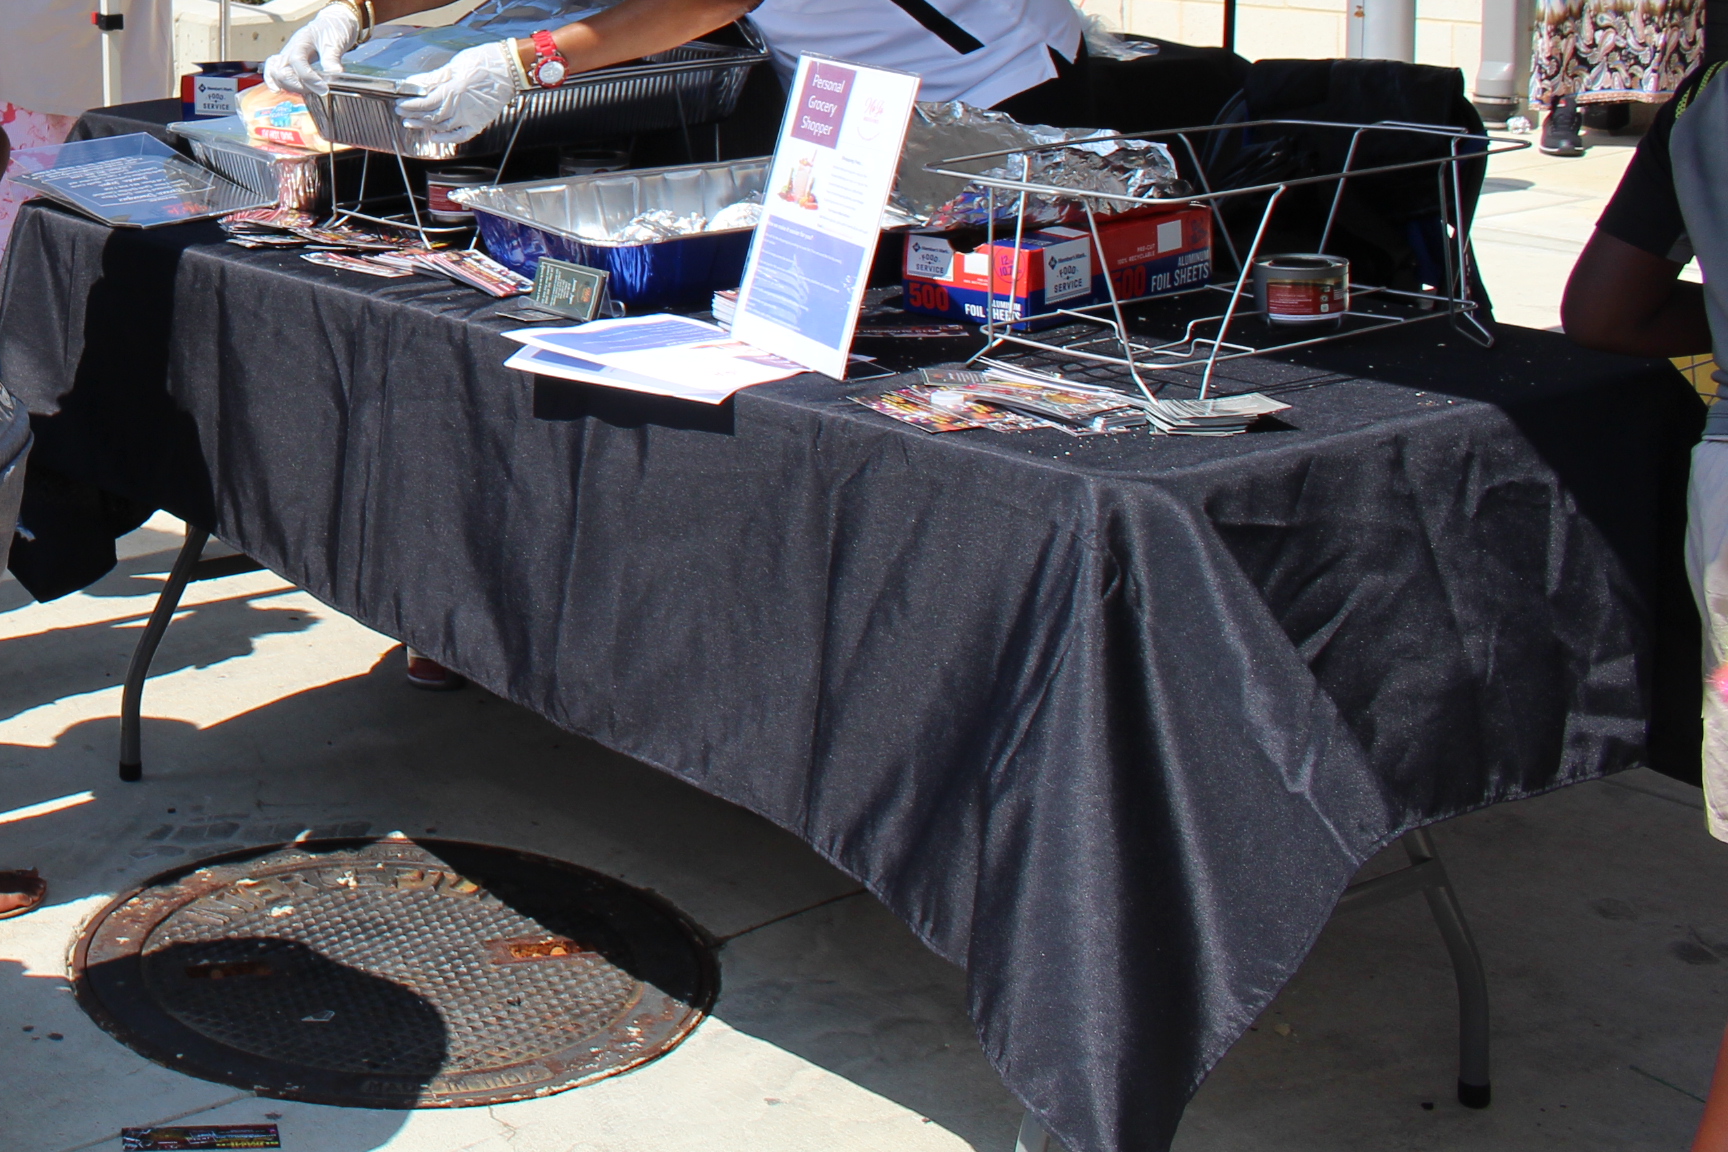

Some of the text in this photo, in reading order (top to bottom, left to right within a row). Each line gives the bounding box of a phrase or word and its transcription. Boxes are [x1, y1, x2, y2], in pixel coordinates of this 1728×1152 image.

[812, 74, 846, 94] Personal
[808, 95, 838, 118] Grocery
[801, 115, 834, 136] Shopper
[921, 254, 939, 262] FOOD
[1178, 249, 1210, 267] ALUMINUM
[916, 264, 944, 273] SERVICE
[1059, 265, 1076, 277] FOOD
[1151, 262, 1210, 293] FOIL SHEETS
[1054, 278, 1082, 293] SERVICE
[909, 282, 950, 311] 500
[964, 303, 987, 318] FOIL
